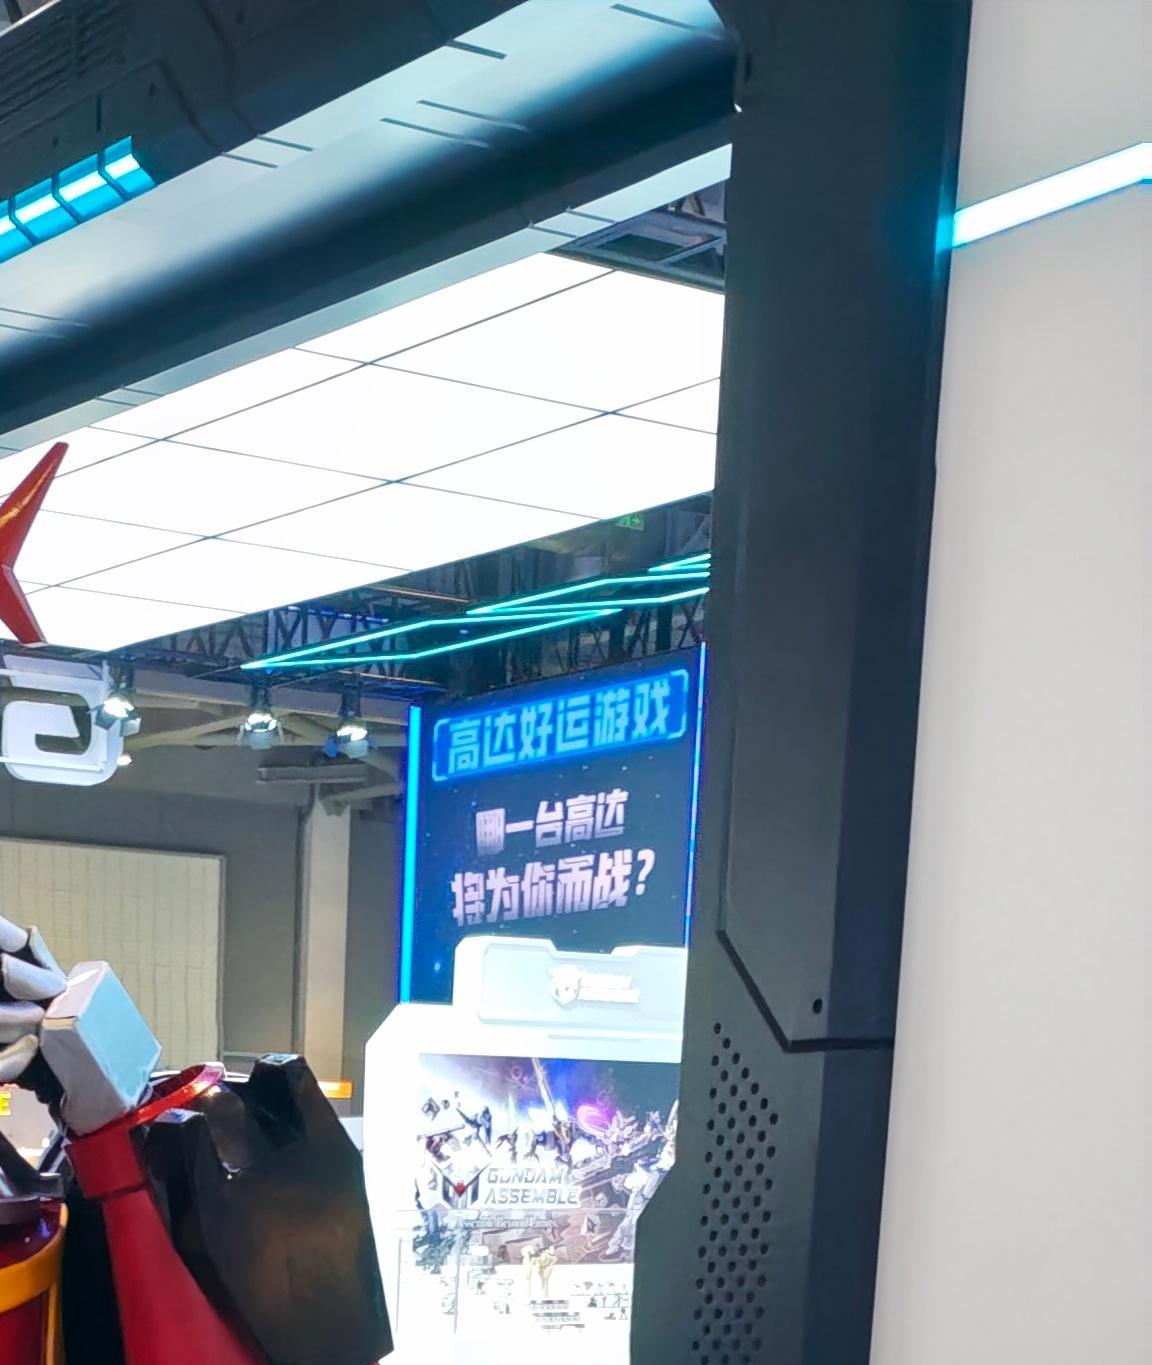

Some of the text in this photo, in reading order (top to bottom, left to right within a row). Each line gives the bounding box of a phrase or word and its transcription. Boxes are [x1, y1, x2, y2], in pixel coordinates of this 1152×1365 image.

[448, 678, 672, 775] 高达好运游戏
[486, 1167, 564, 1185] GUNDAM
[484, 1187, 580, 1205] ASSEMBLE
